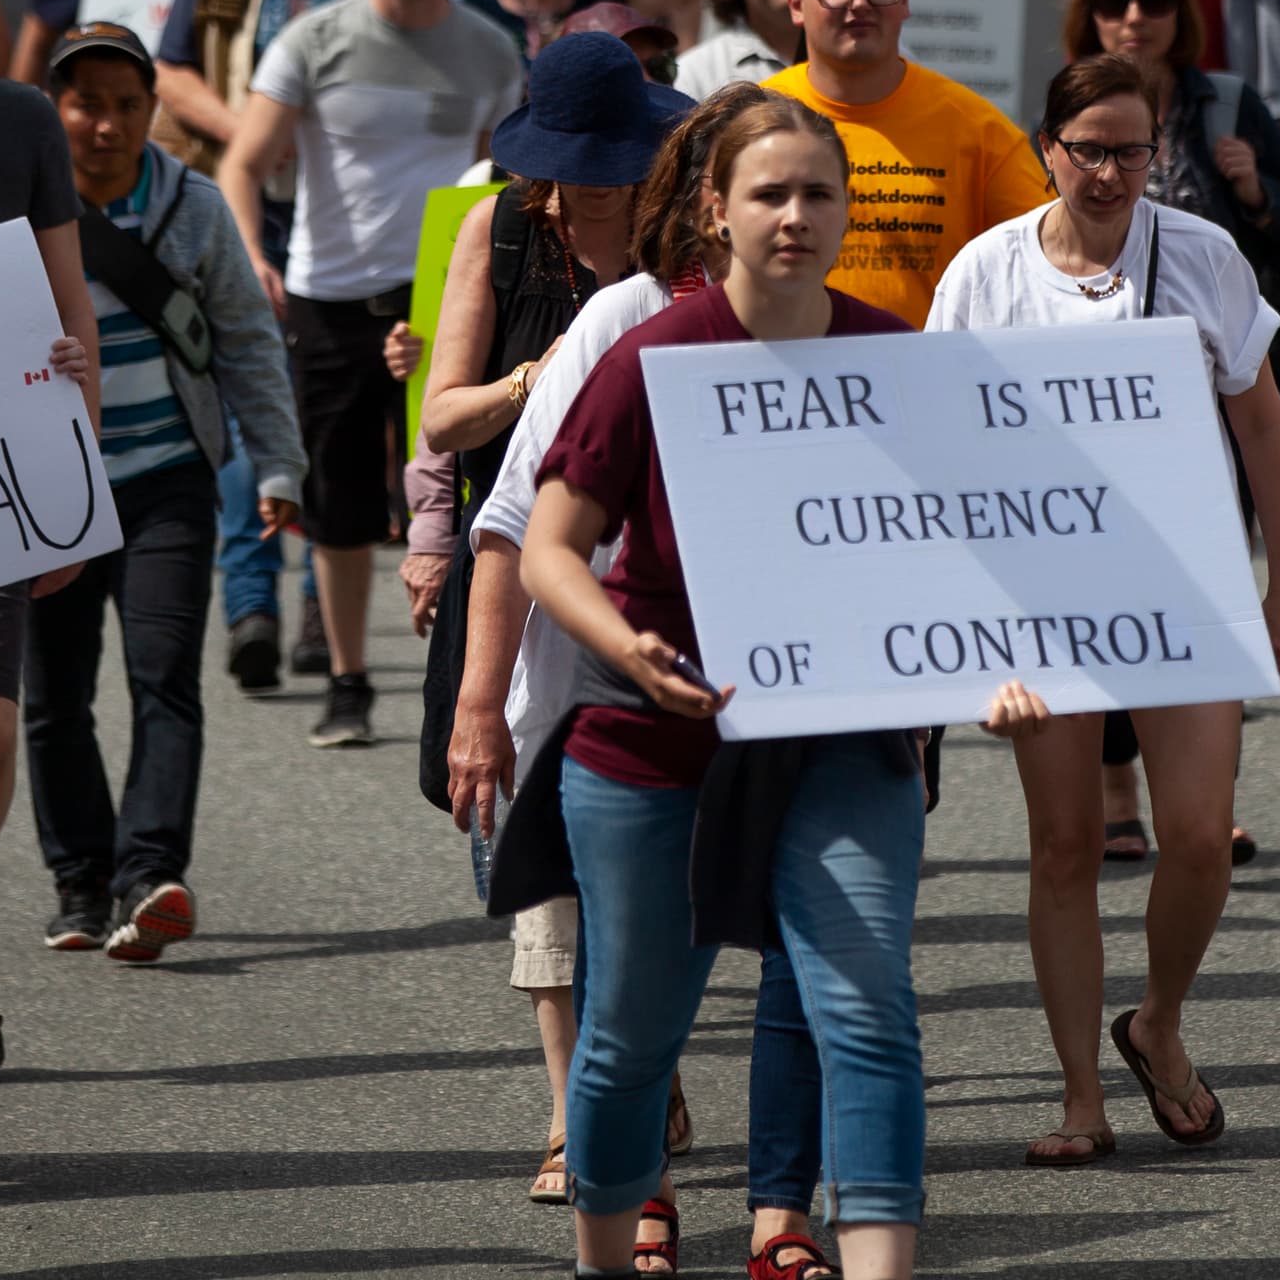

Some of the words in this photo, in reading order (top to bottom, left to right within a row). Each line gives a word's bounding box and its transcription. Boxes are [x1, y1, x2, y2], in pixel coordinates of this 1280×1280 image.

[712, 373, 886, 436] FEAR
[976, 382, 1028, 429] IS
[1044, 374, 1161, 424] THE
[794, 486, 1109, 547] CURRENCY
[747, 642, 812, 688] OF
[882, 611, 1193, 677] CONTROL
